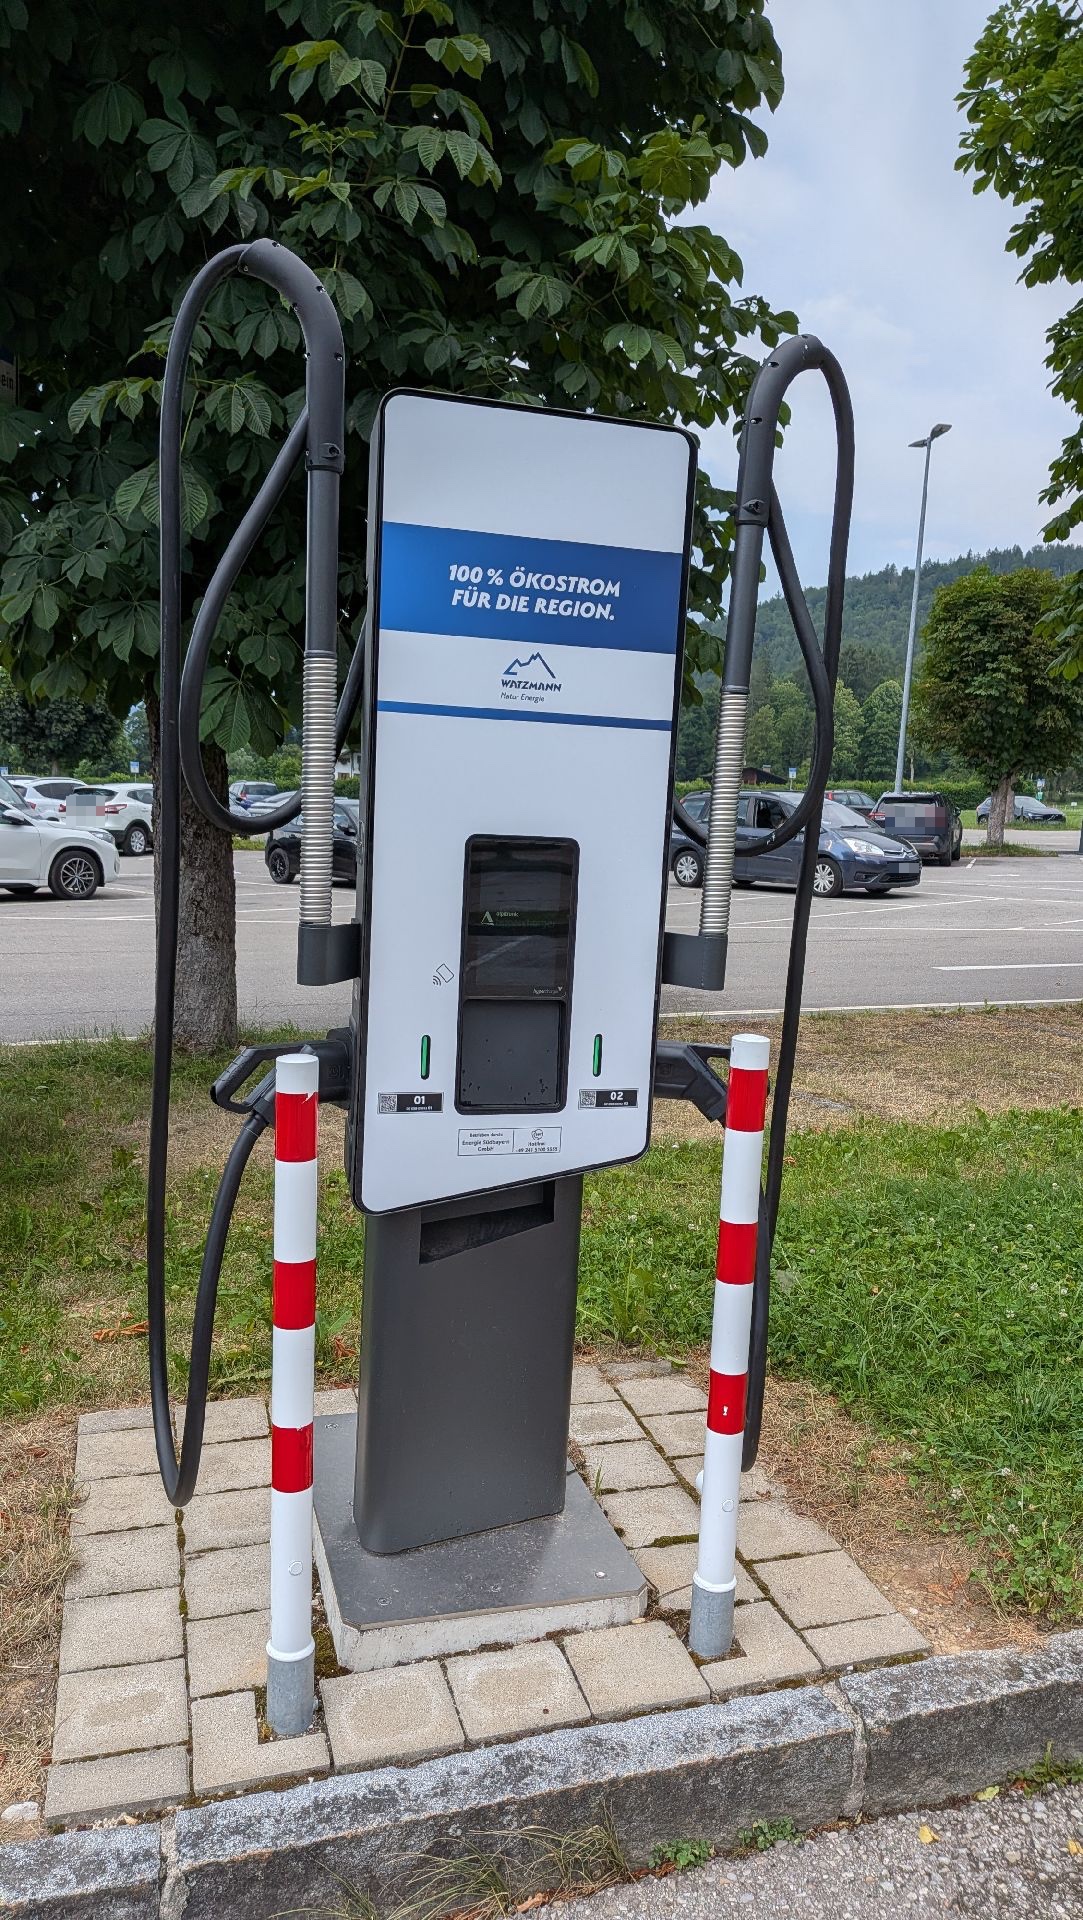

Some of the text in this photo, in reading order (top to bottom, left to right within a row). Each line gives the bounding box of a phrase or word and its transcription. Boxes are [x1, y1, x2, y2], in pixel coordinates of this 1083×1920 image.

[449, 564, 621, 597] 100 % ÖKOSTROM
[451, 586, 615, 621] FÜR DIE REGION.
[501, 679, 562, 692] WATZMANN
[520, 693, 545, 704] Energie
[414, 1095, 426, 1105] 01
[610, 1091, 624, 1101] 02
